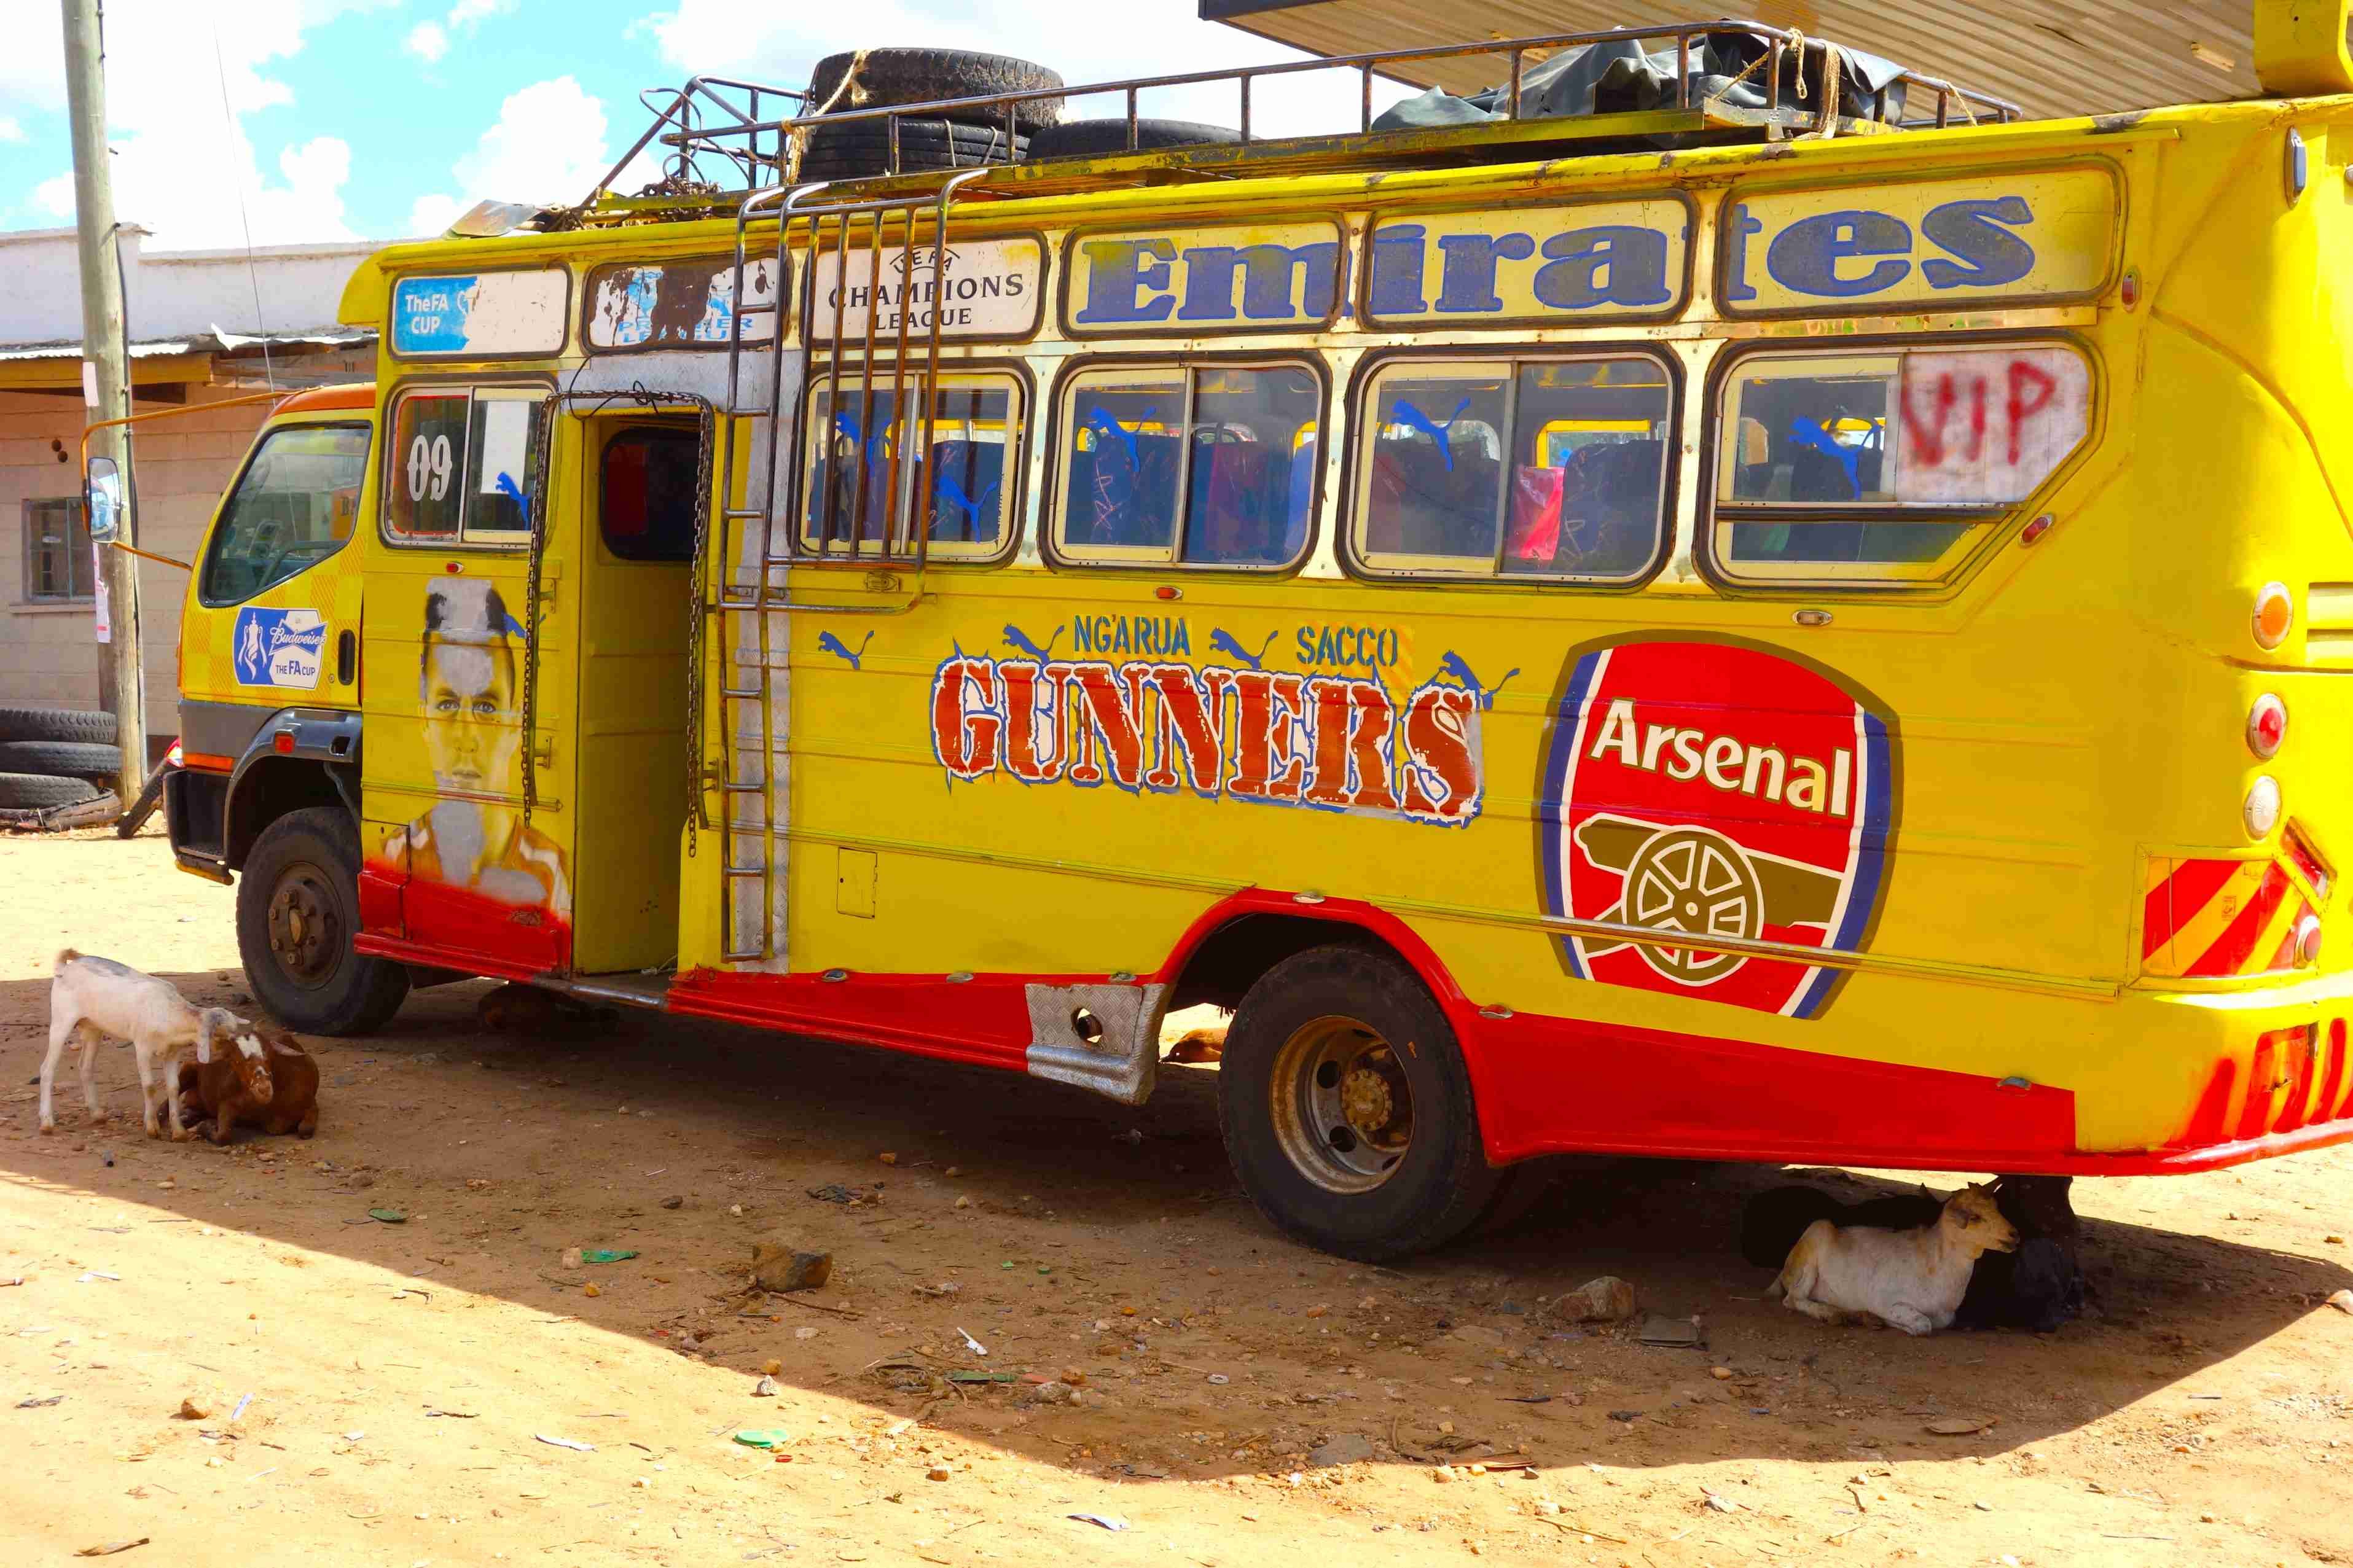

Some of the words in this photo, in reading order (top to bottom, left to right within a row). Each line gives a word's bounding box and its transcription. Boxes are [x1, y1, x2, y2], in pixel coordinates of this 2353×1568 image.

[1075, 195, 2035, 324] Emirates
[828, 273, 1024, 309] CHAMPIONS
[411, 316, 441, 334] CUP
[875, 308, 973, 330] LEAGUE
[1901, 360, 2055, 468] VIP
[407, 434, 452, 502] 09
[269, 626, 327, 645] Budweiser
[1296, 626, 1398, 668] SACCO
[275, 665, 288, 675] THE
[289, 660, 302, 676] FA
[302, 666, 315, 676] CUP
[930, 657, 1483, 829] GUNNERS
[1589, 697, 1853, 819] Arsenal
